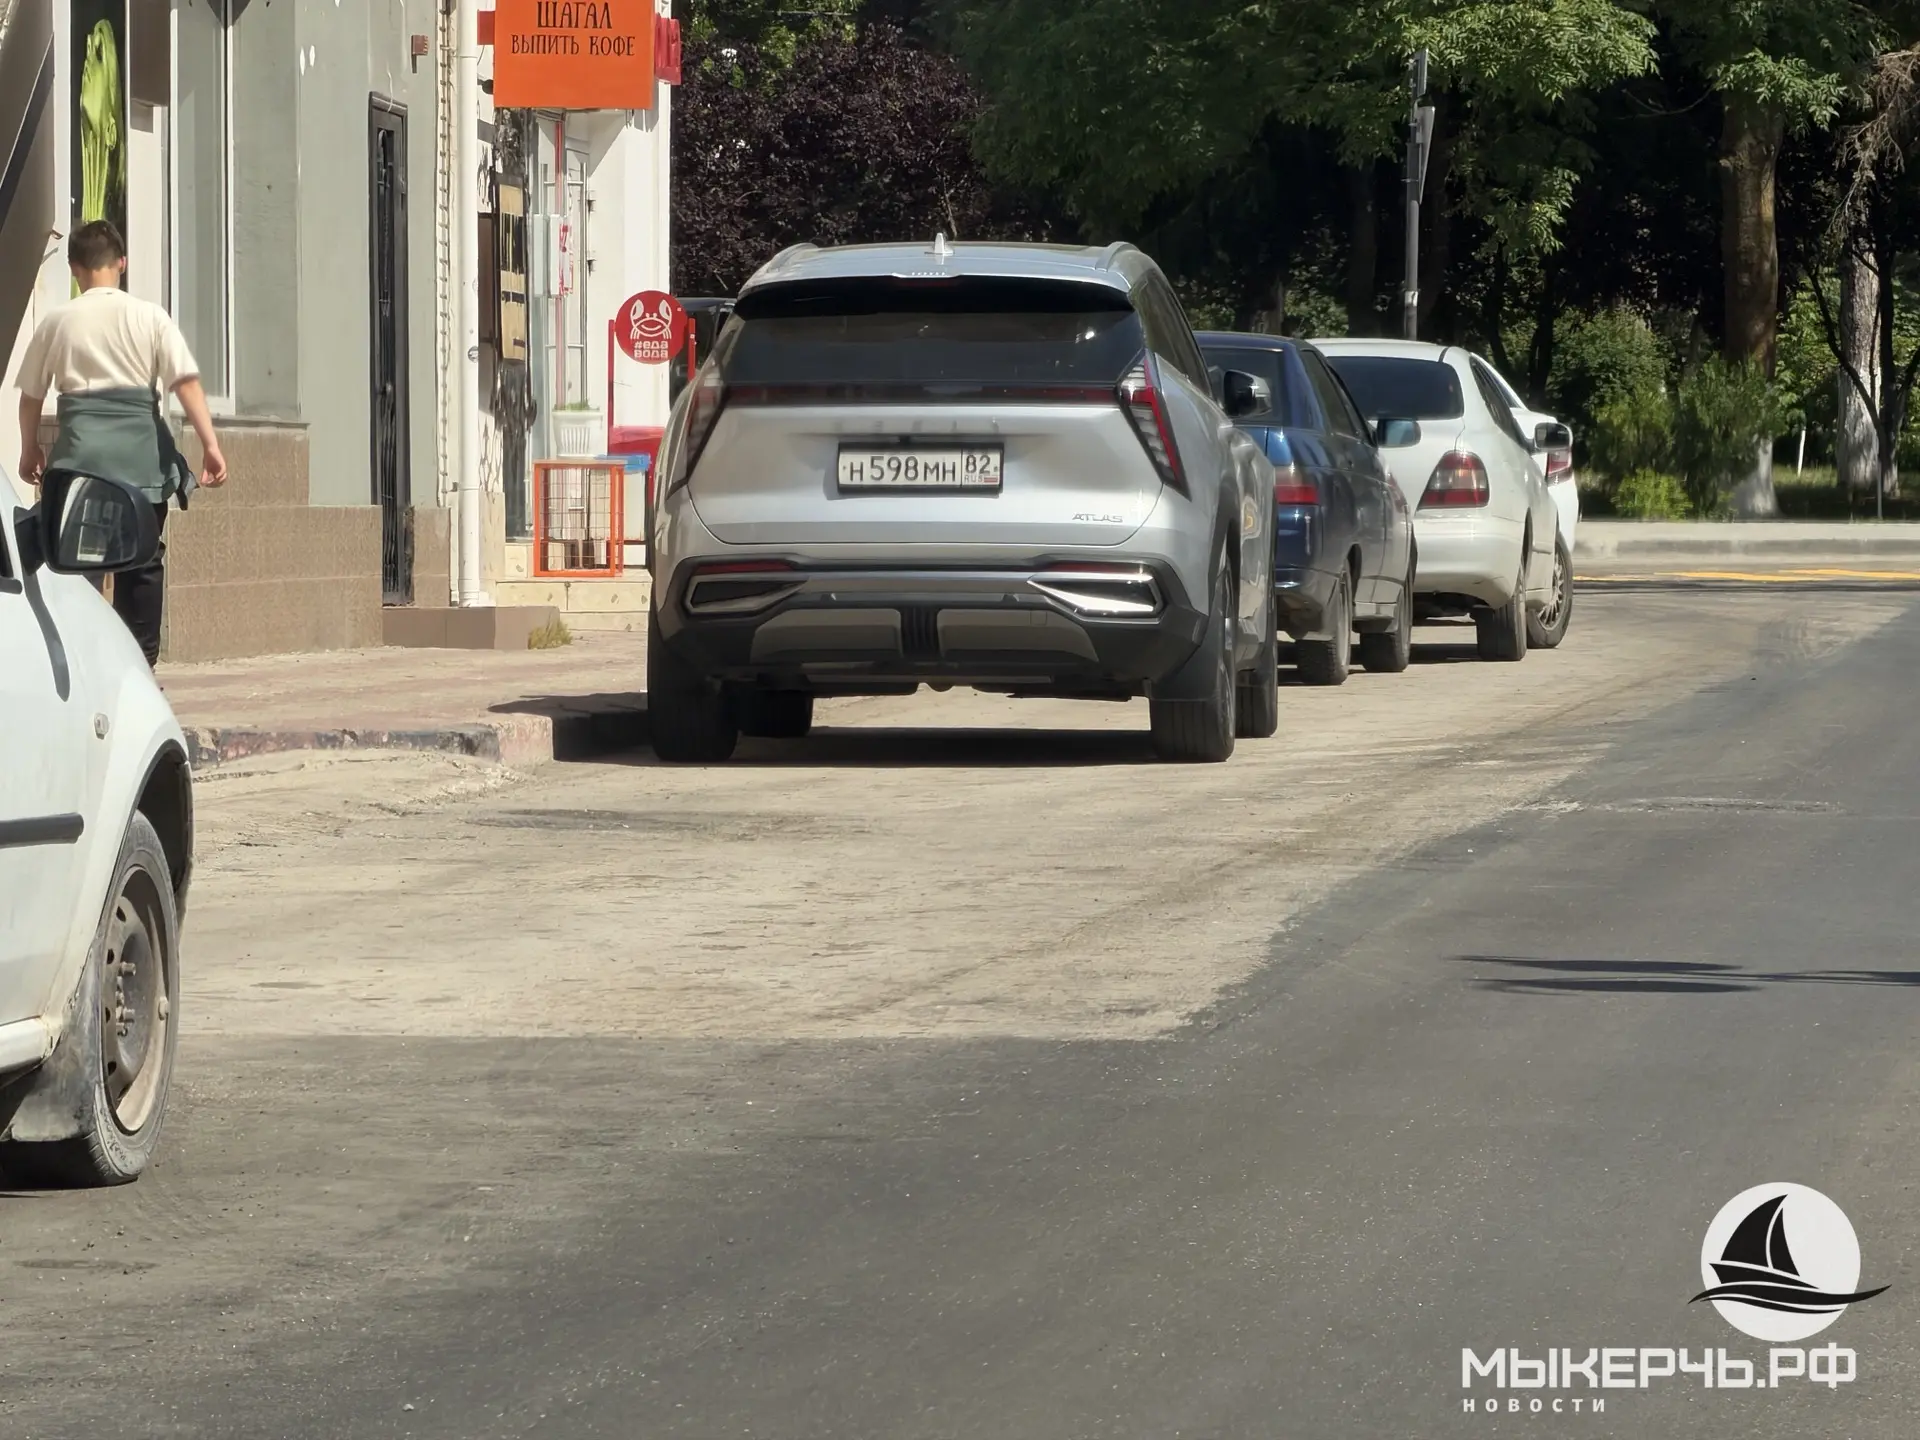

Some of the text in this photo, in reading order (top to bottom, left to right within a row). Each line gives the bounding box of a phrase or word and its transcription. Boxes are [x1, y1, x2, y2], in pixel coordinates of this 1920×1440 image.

[536, 1, 613, 29] ШАГАЛ
[511, 34, 580, 55] ВЫПИТЬ
[589, 35, 636, 57] КОФЕ
[964, 474, 984, 484] RUS
[1071, 513, 1123, 523] ATLAS
